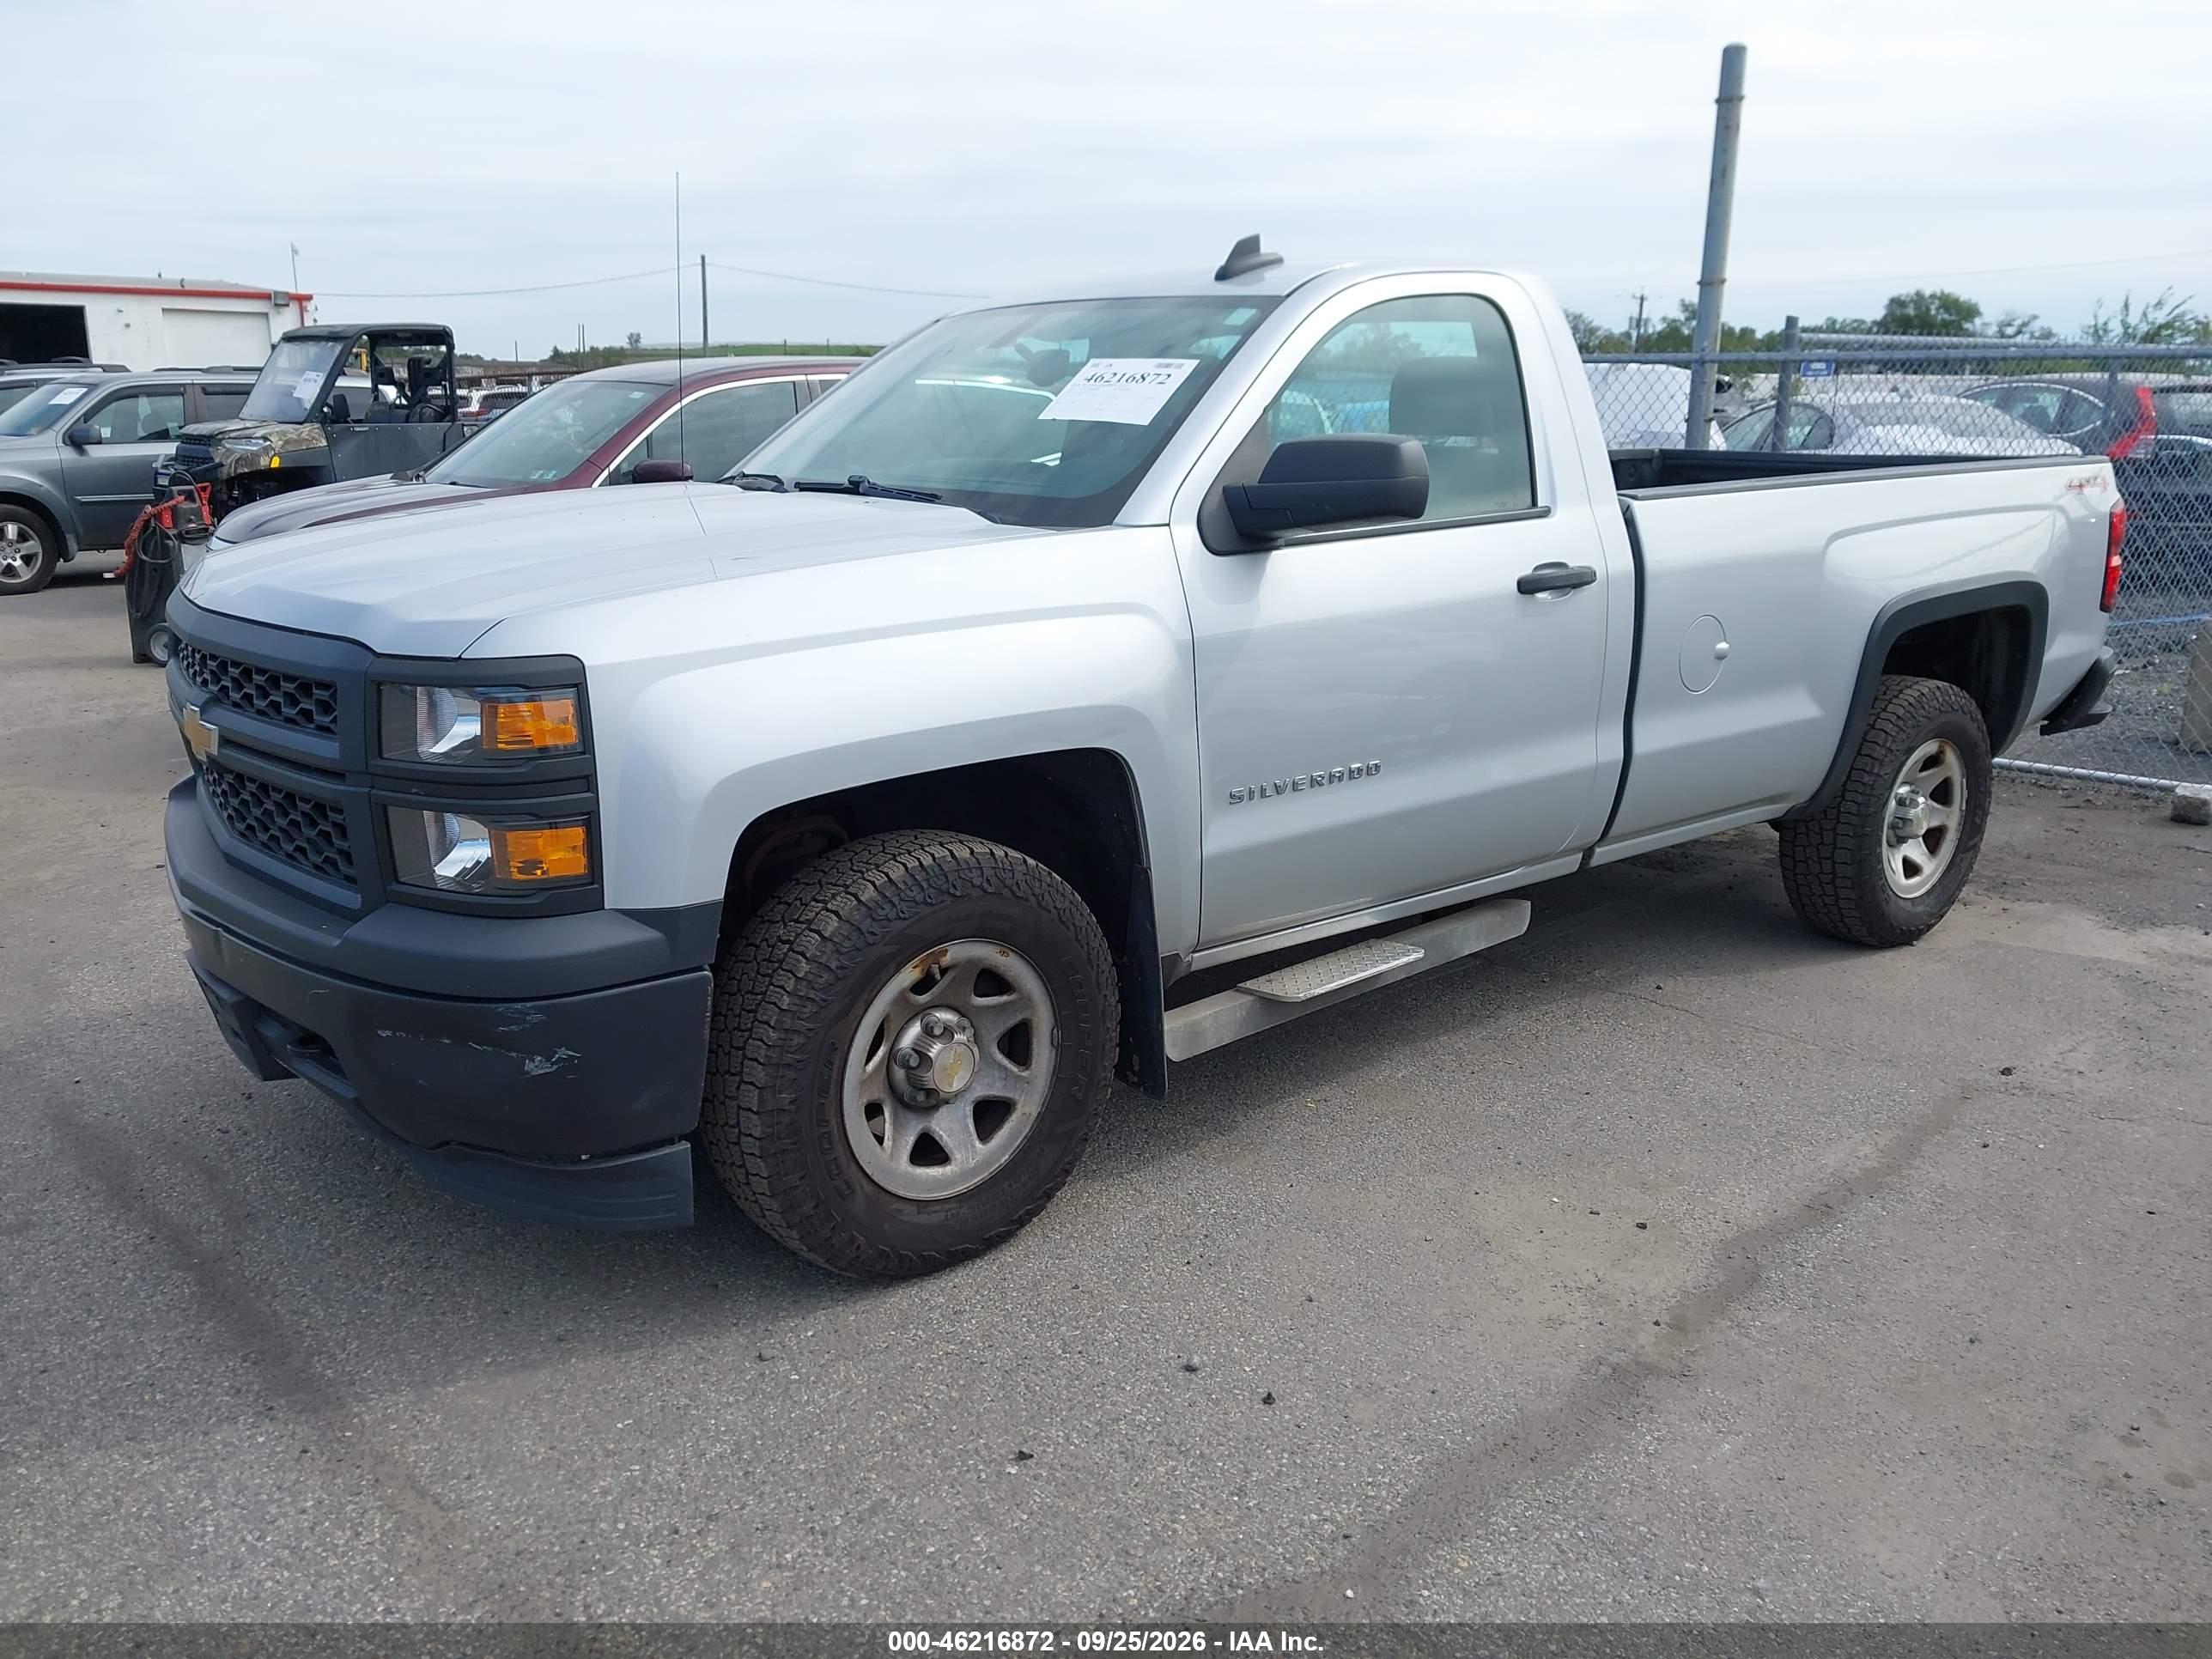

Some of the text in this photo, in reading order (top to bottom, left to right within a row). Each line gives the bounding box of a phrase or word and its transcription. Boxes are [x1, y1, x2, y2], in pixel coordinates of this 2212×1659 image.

[1084, 372, 1172, 385] 46216872
[1229, 760, 1382, 805] SILVERADO
[817, 1039, 854, 1199] COOPER
